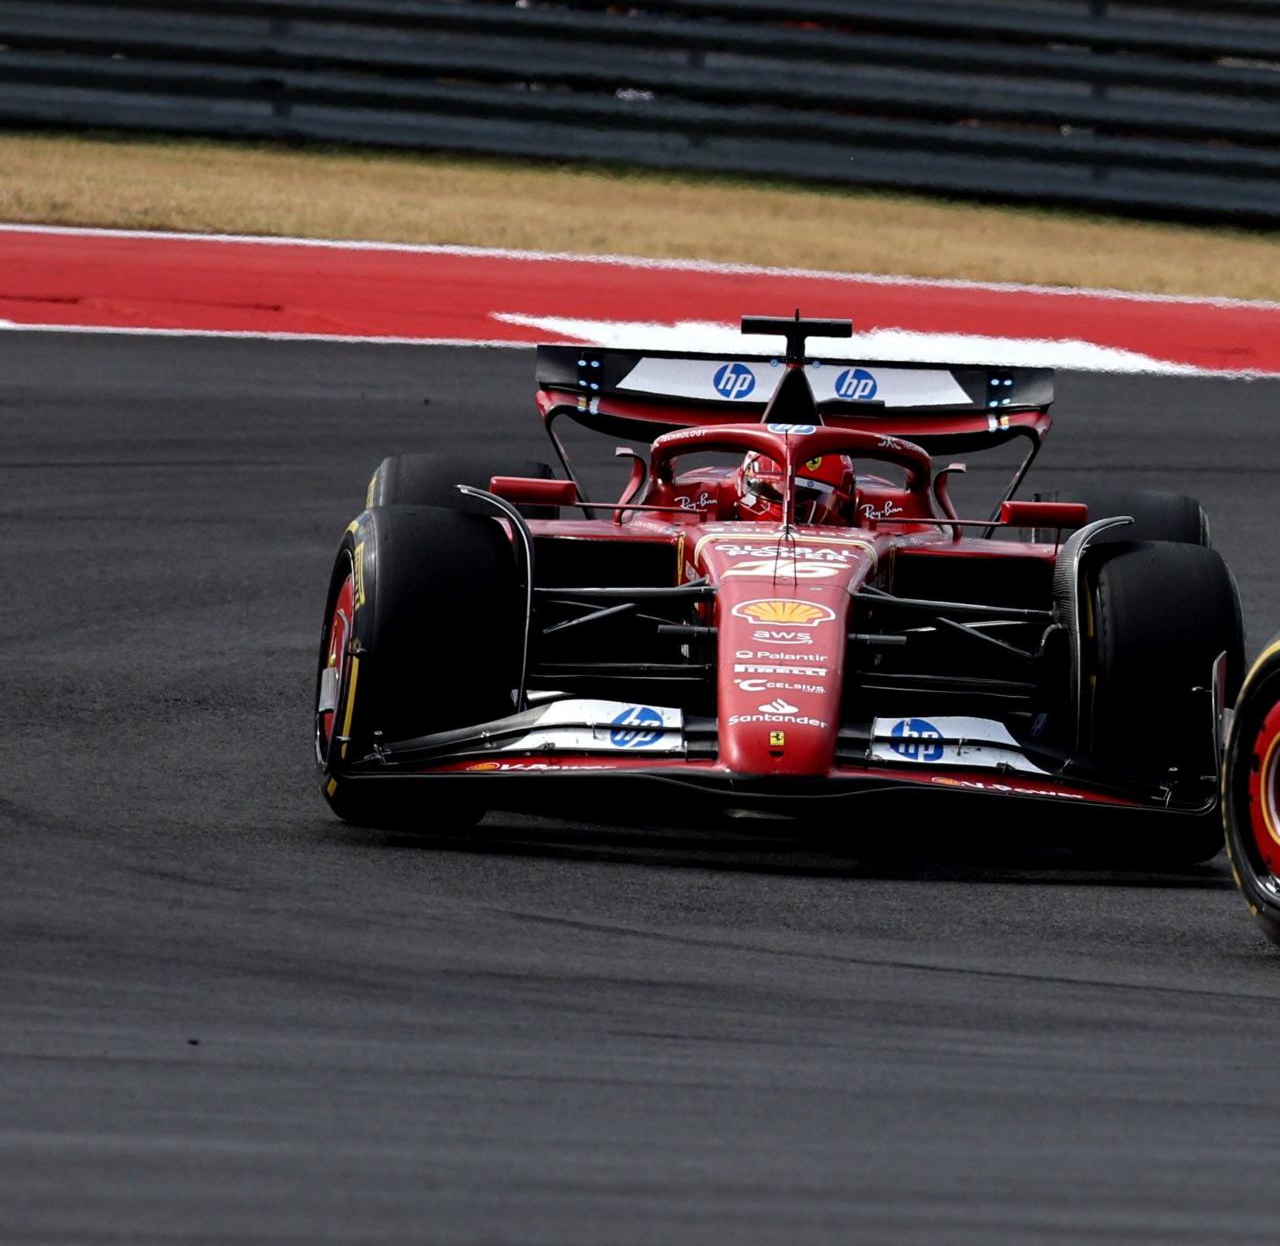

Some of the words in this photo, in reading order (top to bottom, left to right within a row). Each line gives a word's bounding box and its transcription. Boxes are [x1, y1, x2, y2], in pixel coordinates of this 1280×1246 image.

[713, 363, 756, 399] hp
[835, 369, 877, 401] hp
[860, 500, 904, 520] Ray-Ban
[714, 544, 860, 559] GLOBAL
[726, 550, 848, 562] POKER
[720, 559, 853, 579] 16
[753, 630, 812, 640] aws
[757, 651, 828, 662] Palantir
[733, 663, 828, 677] PIRELLI
[610, 706, 664, 748] hp
[727, 713, 829, 729] Santander
[889, 718, 945, 762] hp
